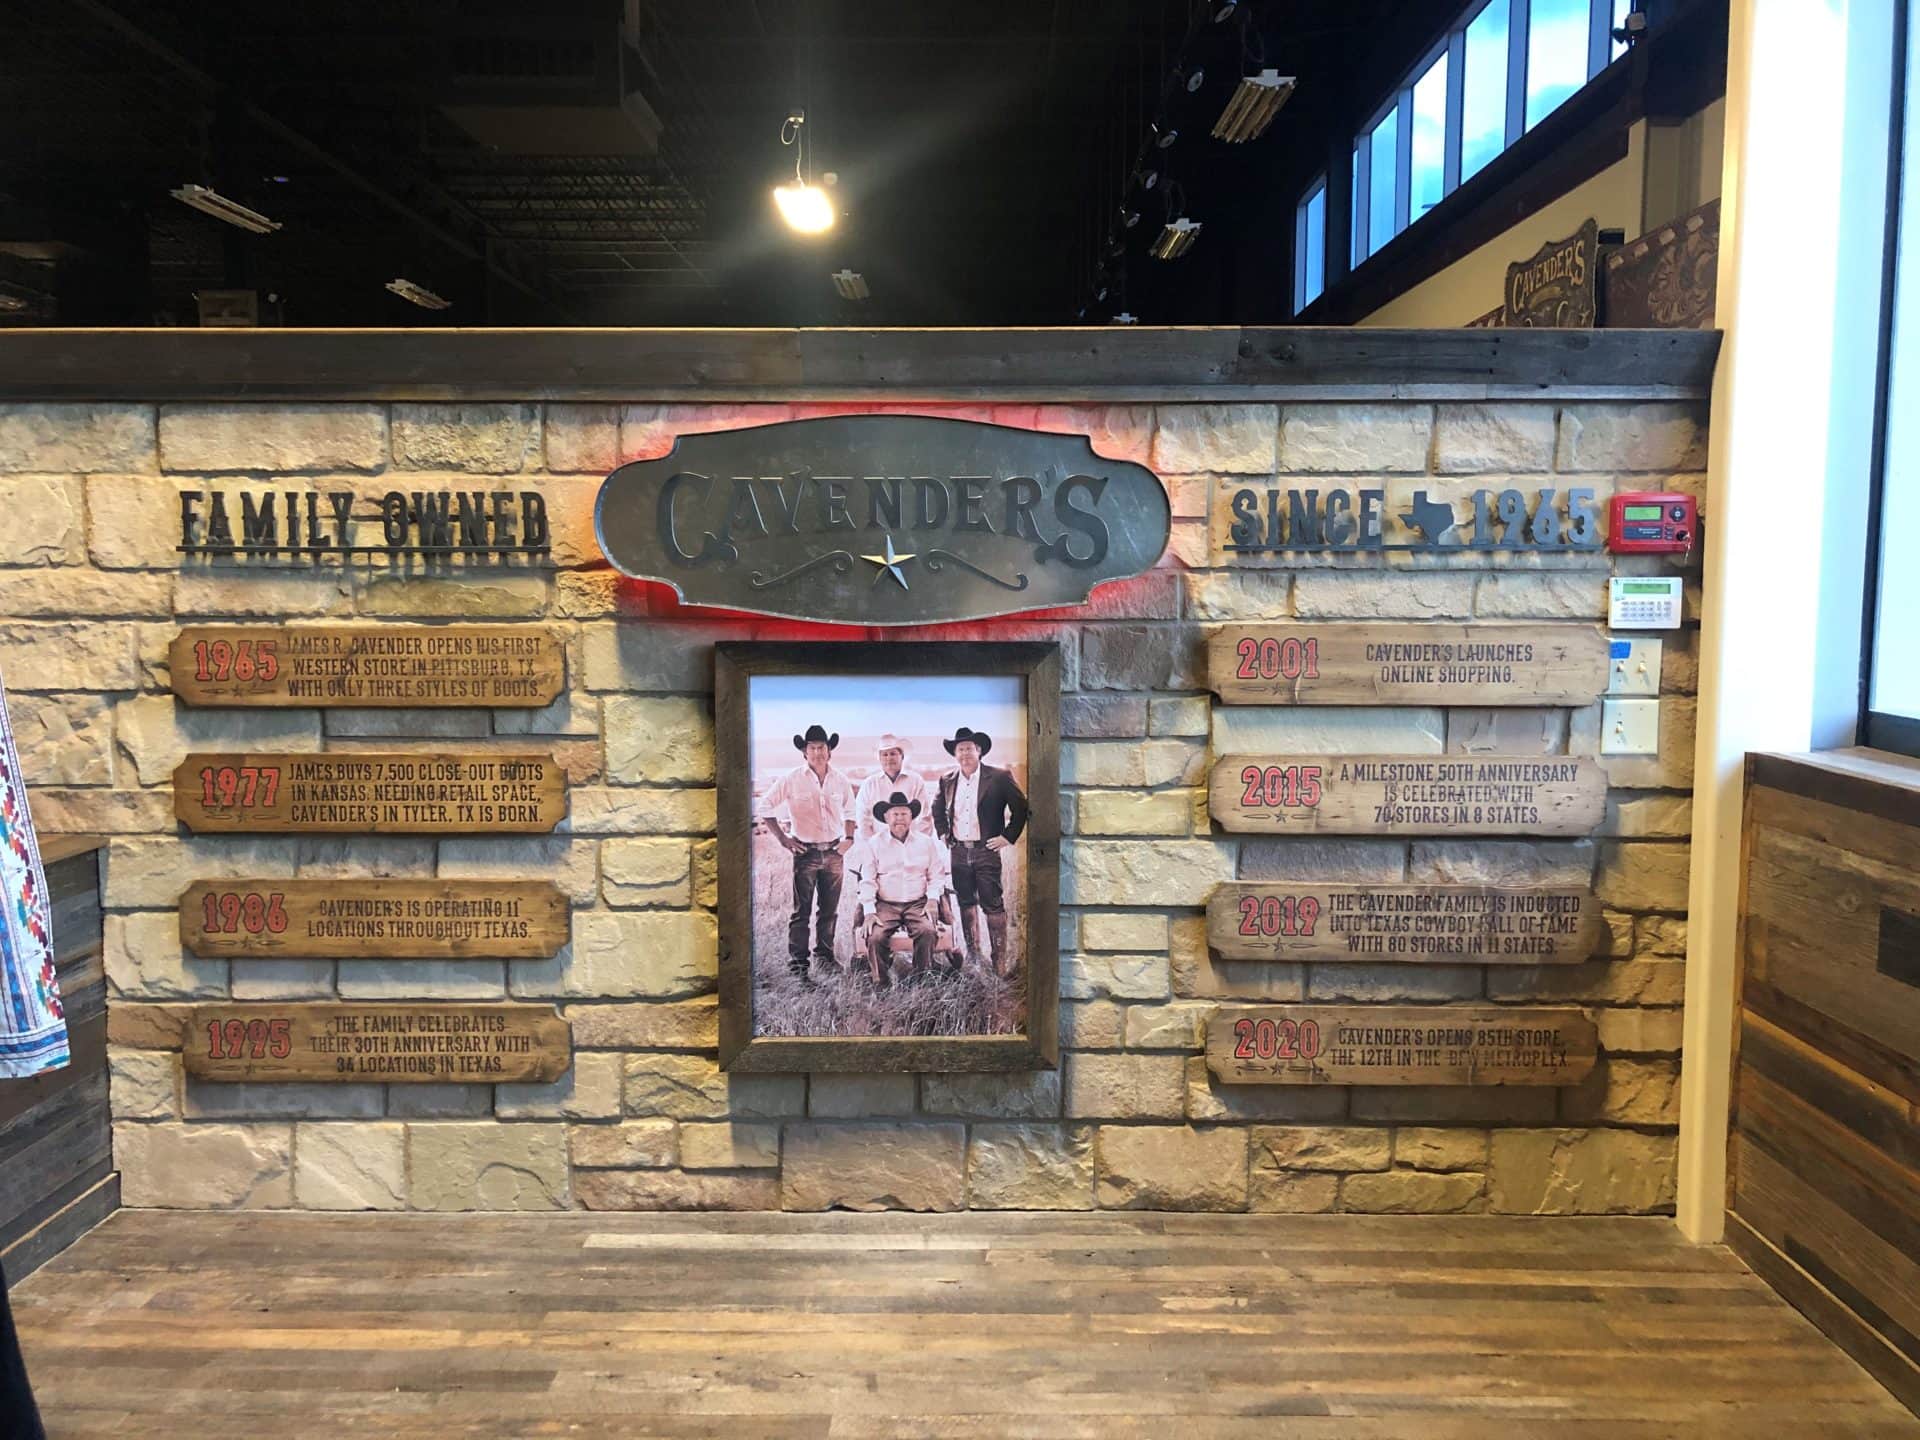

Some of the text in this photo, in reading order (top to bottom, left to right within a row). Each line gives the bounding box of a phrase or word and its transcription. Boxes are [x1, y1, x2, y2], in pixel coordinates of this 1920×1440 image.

[1512, 239, 1585, 314] CAVENDER'S
[179, 490, 548, 547] FAMILY OWNED
[656, 466, 1110, 569] CAVENDER'S
[1230, 488, 1595, 545] SINCE 1965
[286, 636, 541, 655] JAMES R. CAVENDER OPENS HIS FIRST
[1366, 643, 1533, 662] CAVENDER'S LAUNCHES
[193, 639, 278, 682] 1965
[293, 658, 359, 676] WESTERN
[364, 658, 408, 676] STORE
[412, 658, 427, 676] IN
[518, 658, 535, 676] TX
[1236, 637, 1319, 679] 2001
[1381, 665, 1516, 683] ONLINE SHOPPING.
[287, 679, 542, 697] WITH ONLY THREE STYLES OF BOOTS.
[288, 763, 543, 782] JAMES BUYS 7,500 CLOSE-OUT BOOTS
[1340, 763, 1578, 782] A MILESTONE 50TH ANNIVERSARY
[200, 766, 280, 808] 1977
[292, 784, 306, 801] IN
[374, 784, 436, 801] NEEDING
[440, 784, 488, 802] RETAIL
[492, 784, 541, 803] SPACE,
[1240, 765, 1322, 807] 2015
[1384, 784, 1534, 803] IS CELEBRATED WITH
[291, 805, 379, 822] CAVENDER'S
[383, 805, 398, 822] IN
[457, 805, 474, 822] TX
[479, 805, 493, 822] IS
[498, 805, 543, 822] BORN.
[1374, 806, 1542, 824] 70 STORES IN 8 STATES.
[202, 892, 288, 934] 1986
[320, 899, 520, 918] CAVENDER'S IS OPERATING 11
[1328, 894, 1580, 913] THE CAVENDER FAMILY IS INDUCTED
[1238, 895, 1321, 937] 2019
[1330, 914, 1578, 934] INTO TEXAS COWBOY HALL OF FAME
[308, 920, 532, 938] LOCATIONS THROUGHOUT TEXAS.
[1348, 935, 1558, 954] WITH 80 STORES IN 11 STATES.
[334, 1015, 505, 1033] THE FAMILY CELEBRATES
[208, 1018, 293, 1059] 1995
[310, 1035, 530, 1053] THEIR 30TH ANNIVERSARY WITH
[1234, 1018, 1320, 1060] 2020
[1338, 1028, 1423, 1046] CAVENDER'S
[1427, 1029, 1473, 1046] OPENS
[1478, 1029, 1513, 1047] 85TH
[359, 1056, 436, 1073] LOCATIONS
[440, 1056, 455, 1073] IN
[459, 1056, 506, 1073] TEXAS.
[1330, 1048, 1356, 1066] THE
[1360, 1048, 1392, 1066] 12TH
[1397, 1049, 1411, 1066] IN
[1416, 1049, 1441, 1066] THE
